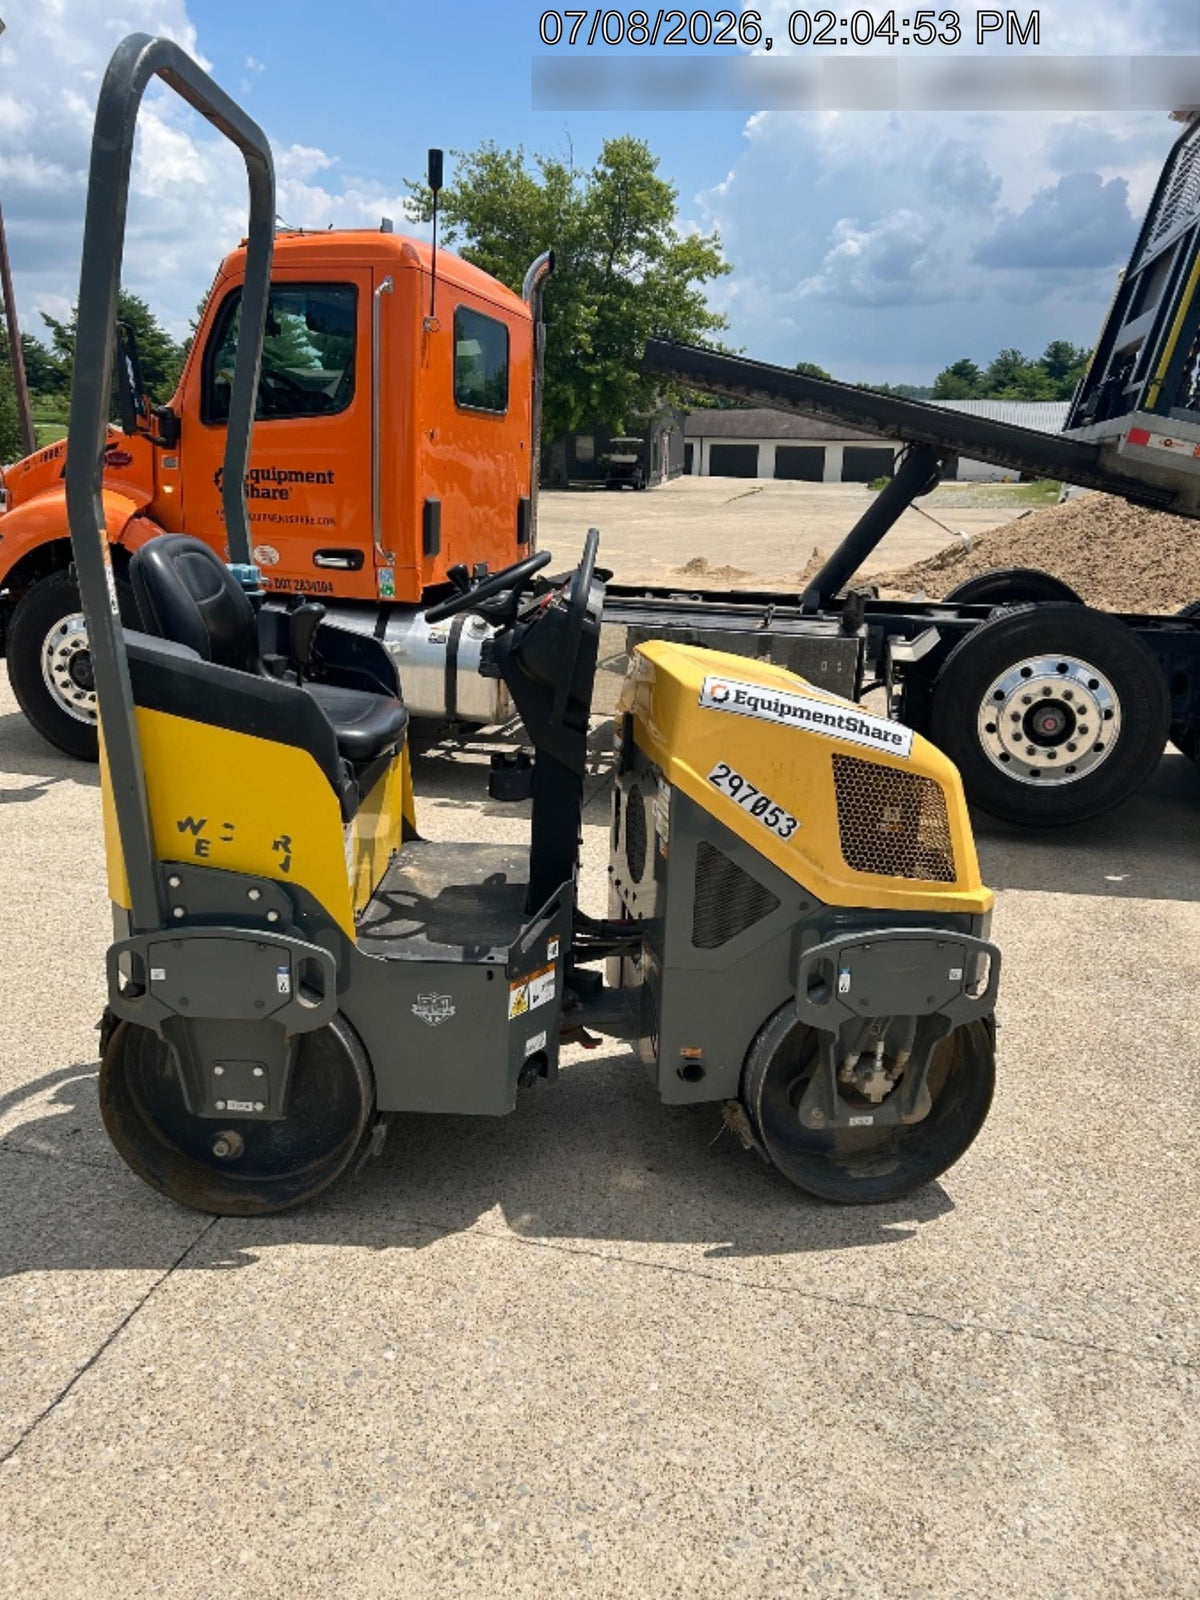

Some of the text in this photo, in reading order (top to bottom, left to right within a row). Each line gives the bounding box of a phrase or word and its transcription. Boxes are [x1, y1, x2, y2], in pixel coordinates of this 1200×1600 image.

[245, 467, 335, 484] quipment
[734, 688, 903, 746] EquipmentShare
[709, 763, 798, 839] 297053
